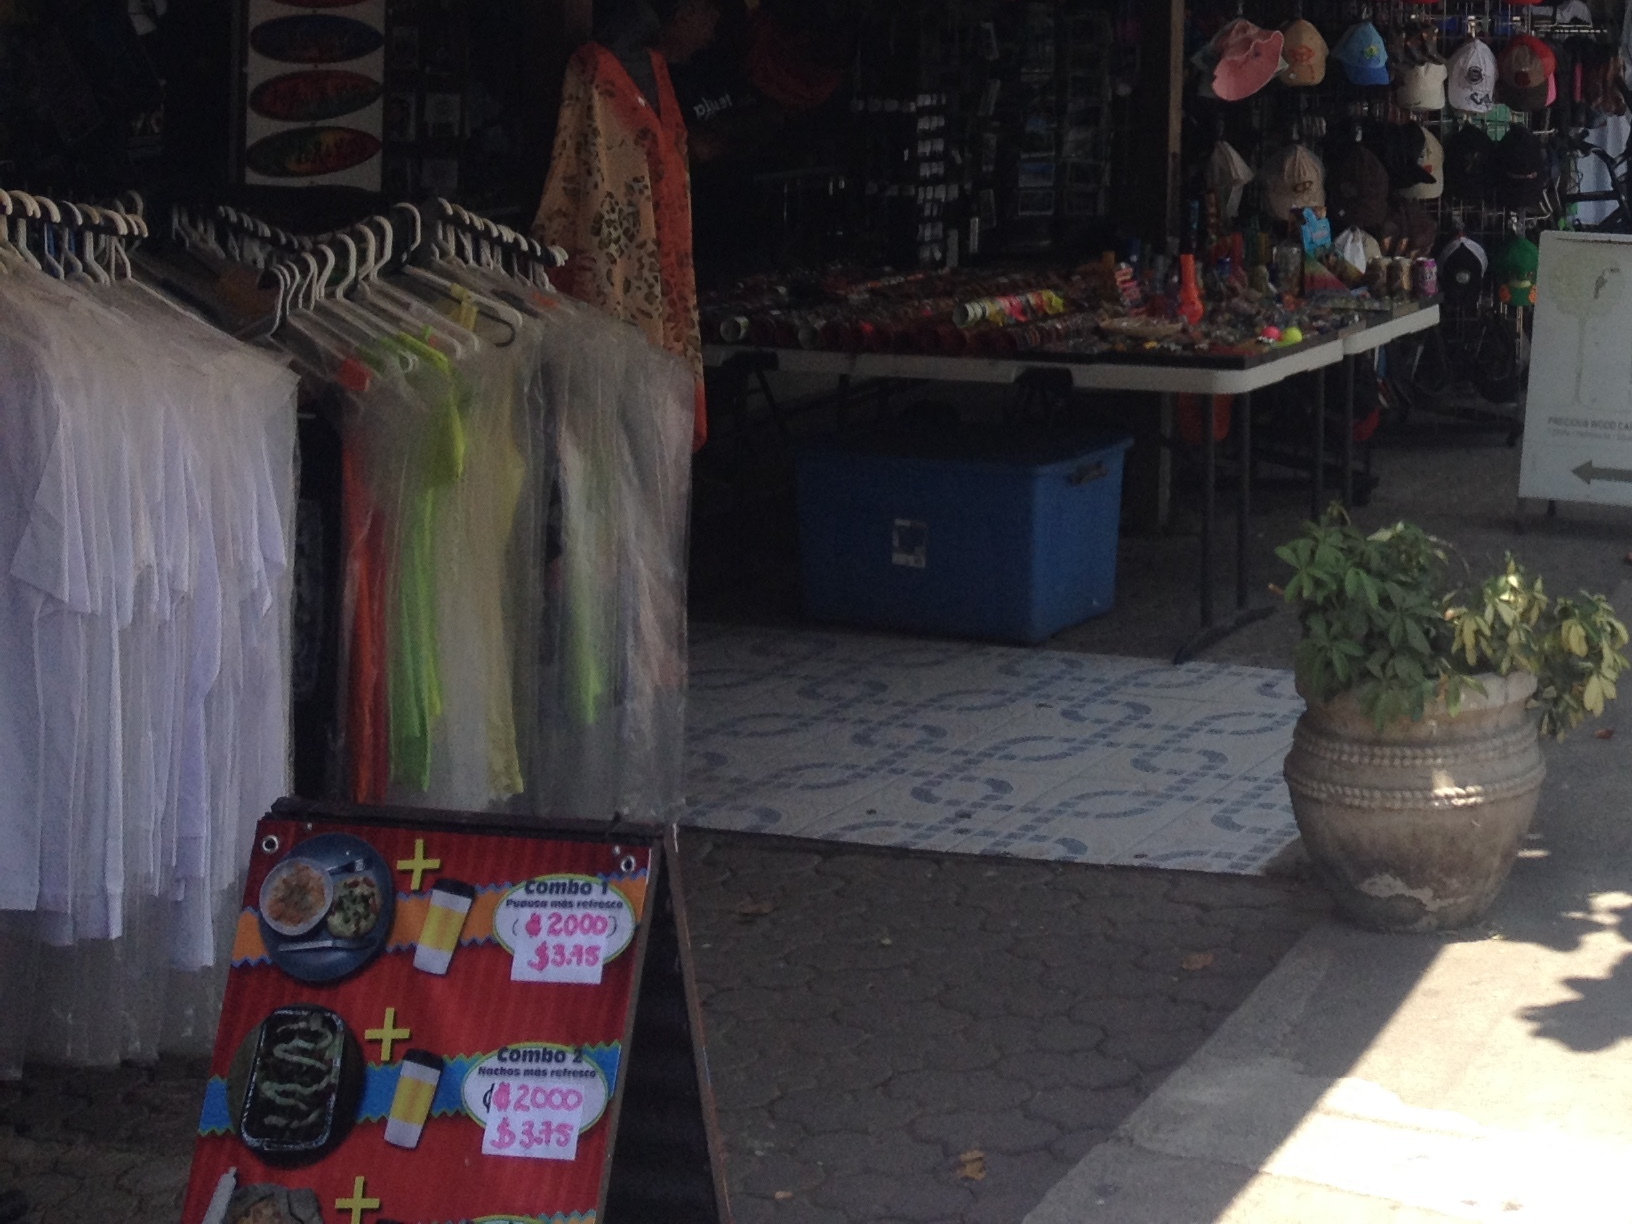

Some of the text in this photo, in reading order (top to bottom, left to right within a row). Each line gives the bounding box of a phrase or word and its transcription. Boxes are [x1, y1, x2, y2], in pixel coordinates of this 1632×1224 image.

[1590, 418, 1617, 431] WOOD
[524, 879, 609, 895] Combo 1
[506, 898, 624, 910] Pupusa más refresco
[497, 1046, 583, 1064] Combo 2
[478, 1066, 521, 1077] Nachos
[550, 1068, 597, 1079] refresco
